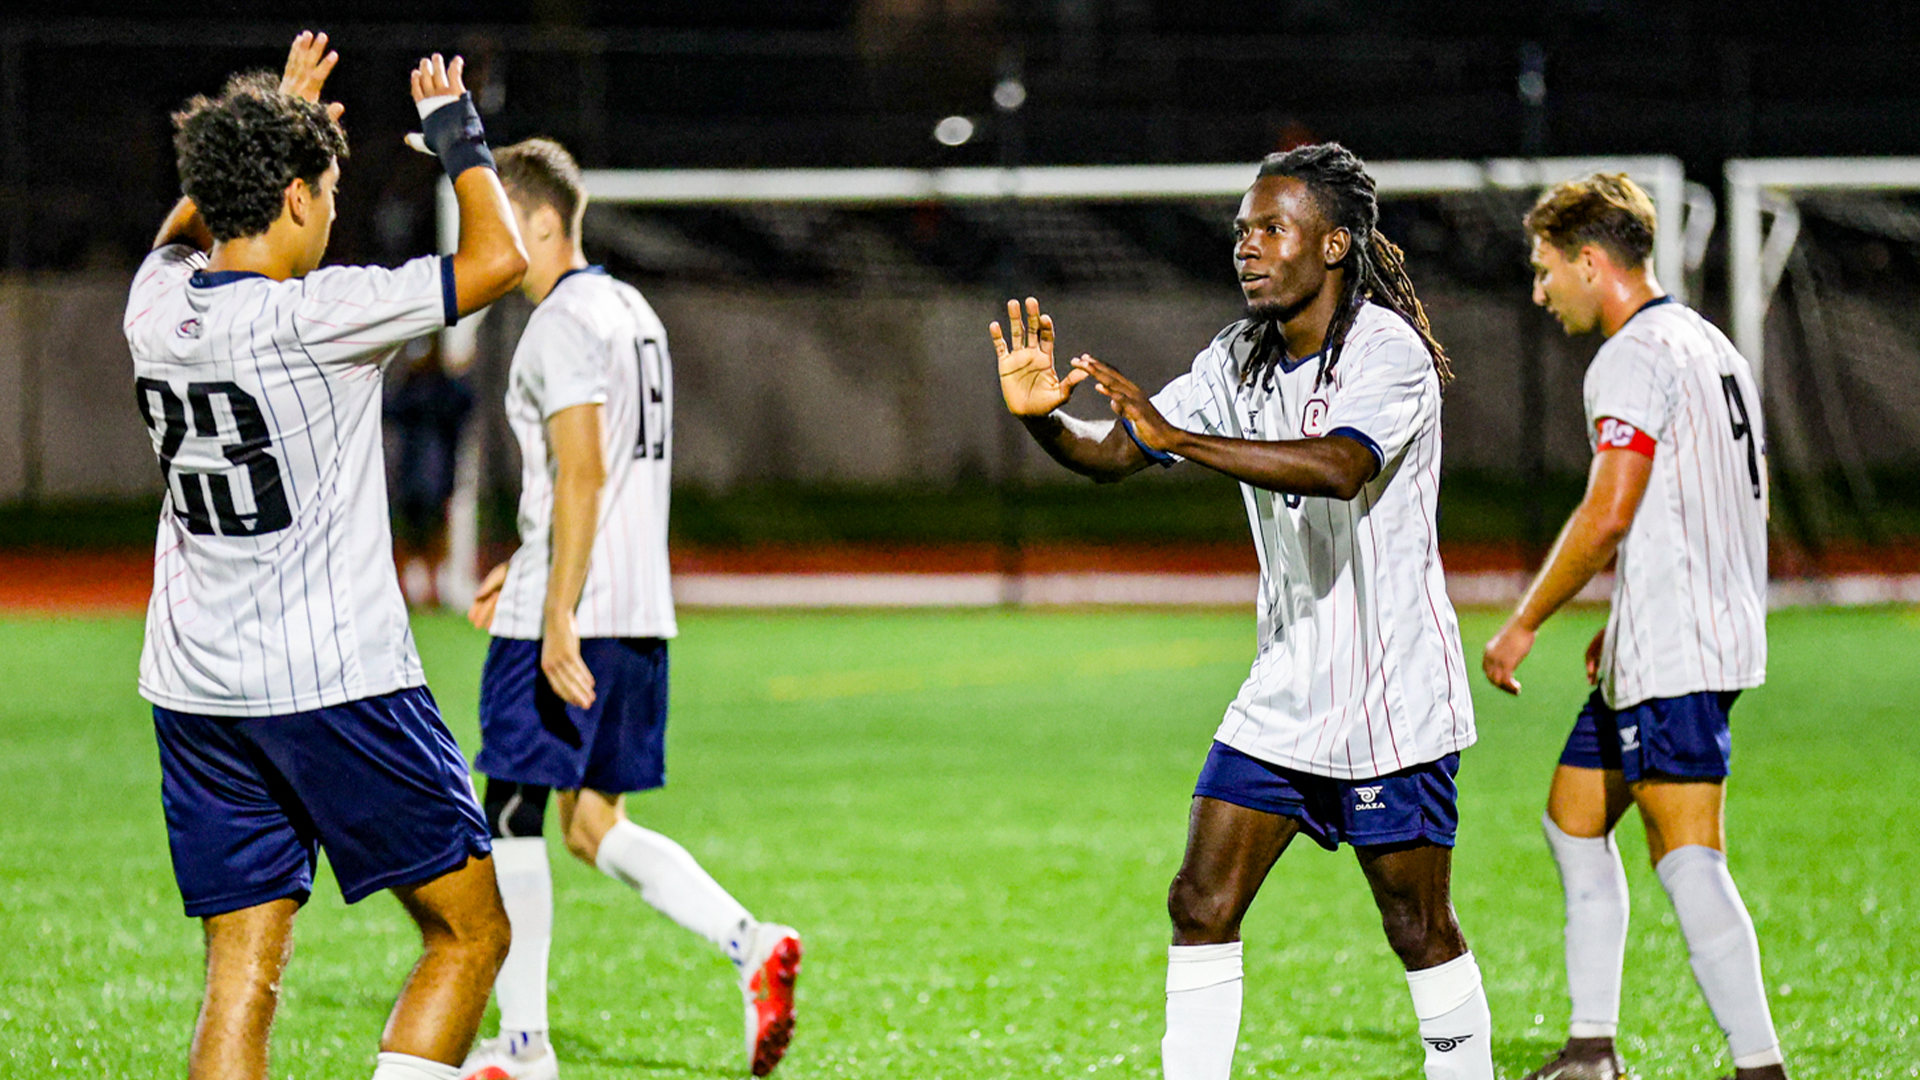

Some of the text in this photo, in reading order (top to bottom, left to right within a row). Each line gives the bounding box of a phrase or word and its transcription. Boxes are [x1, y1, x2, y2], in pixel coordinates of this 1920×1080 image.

[136, 376, 293, 537] 23
[1720, 374, 1761, 499] 4
[1354, 802, 1386, 811] DIAZA
